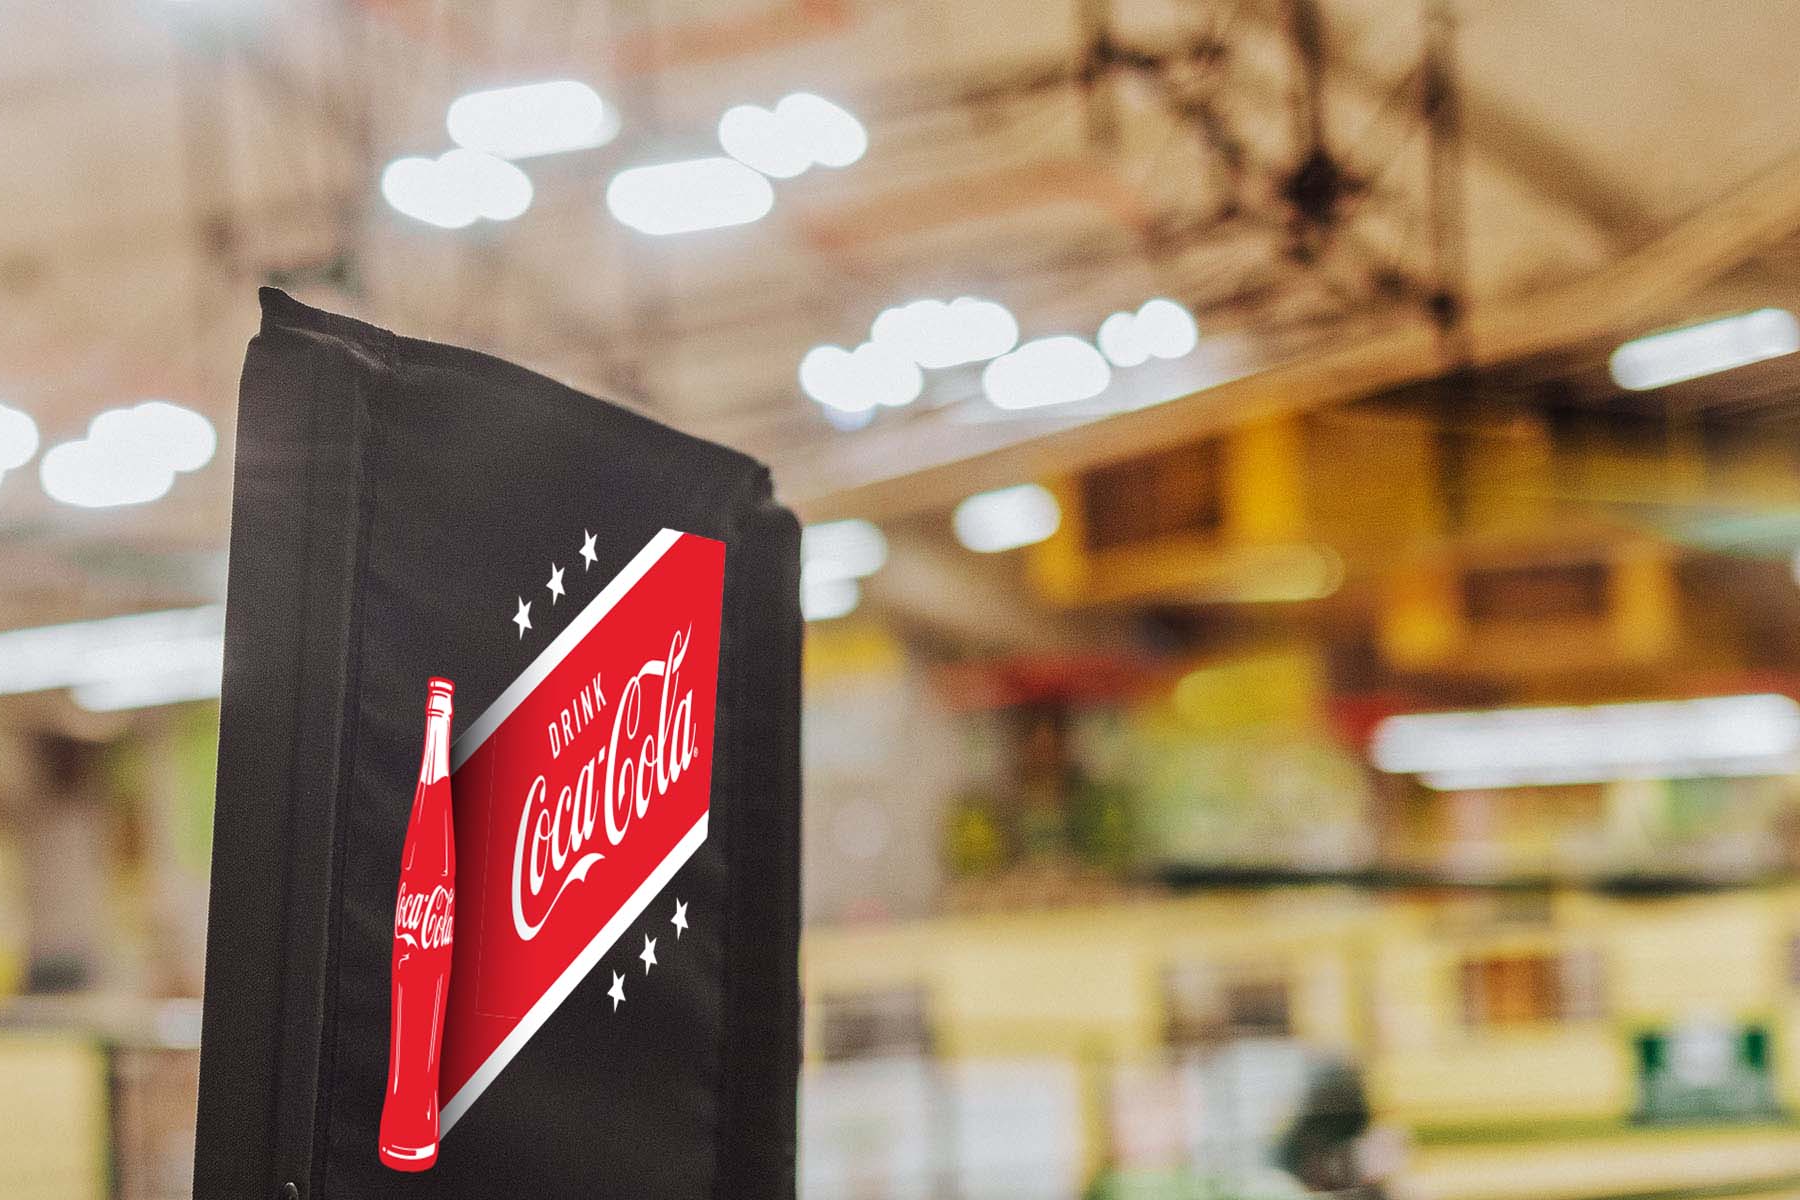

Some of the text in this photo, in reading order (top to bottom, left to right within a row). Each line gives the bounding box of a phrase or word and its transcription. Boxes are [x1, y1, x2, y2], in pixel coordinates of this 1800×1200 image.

[548, 672, 607, 760] DRINK
[512, 620, 697, 942] Coca-Cola
[395, 881, 455, 950] Coca-Cola
